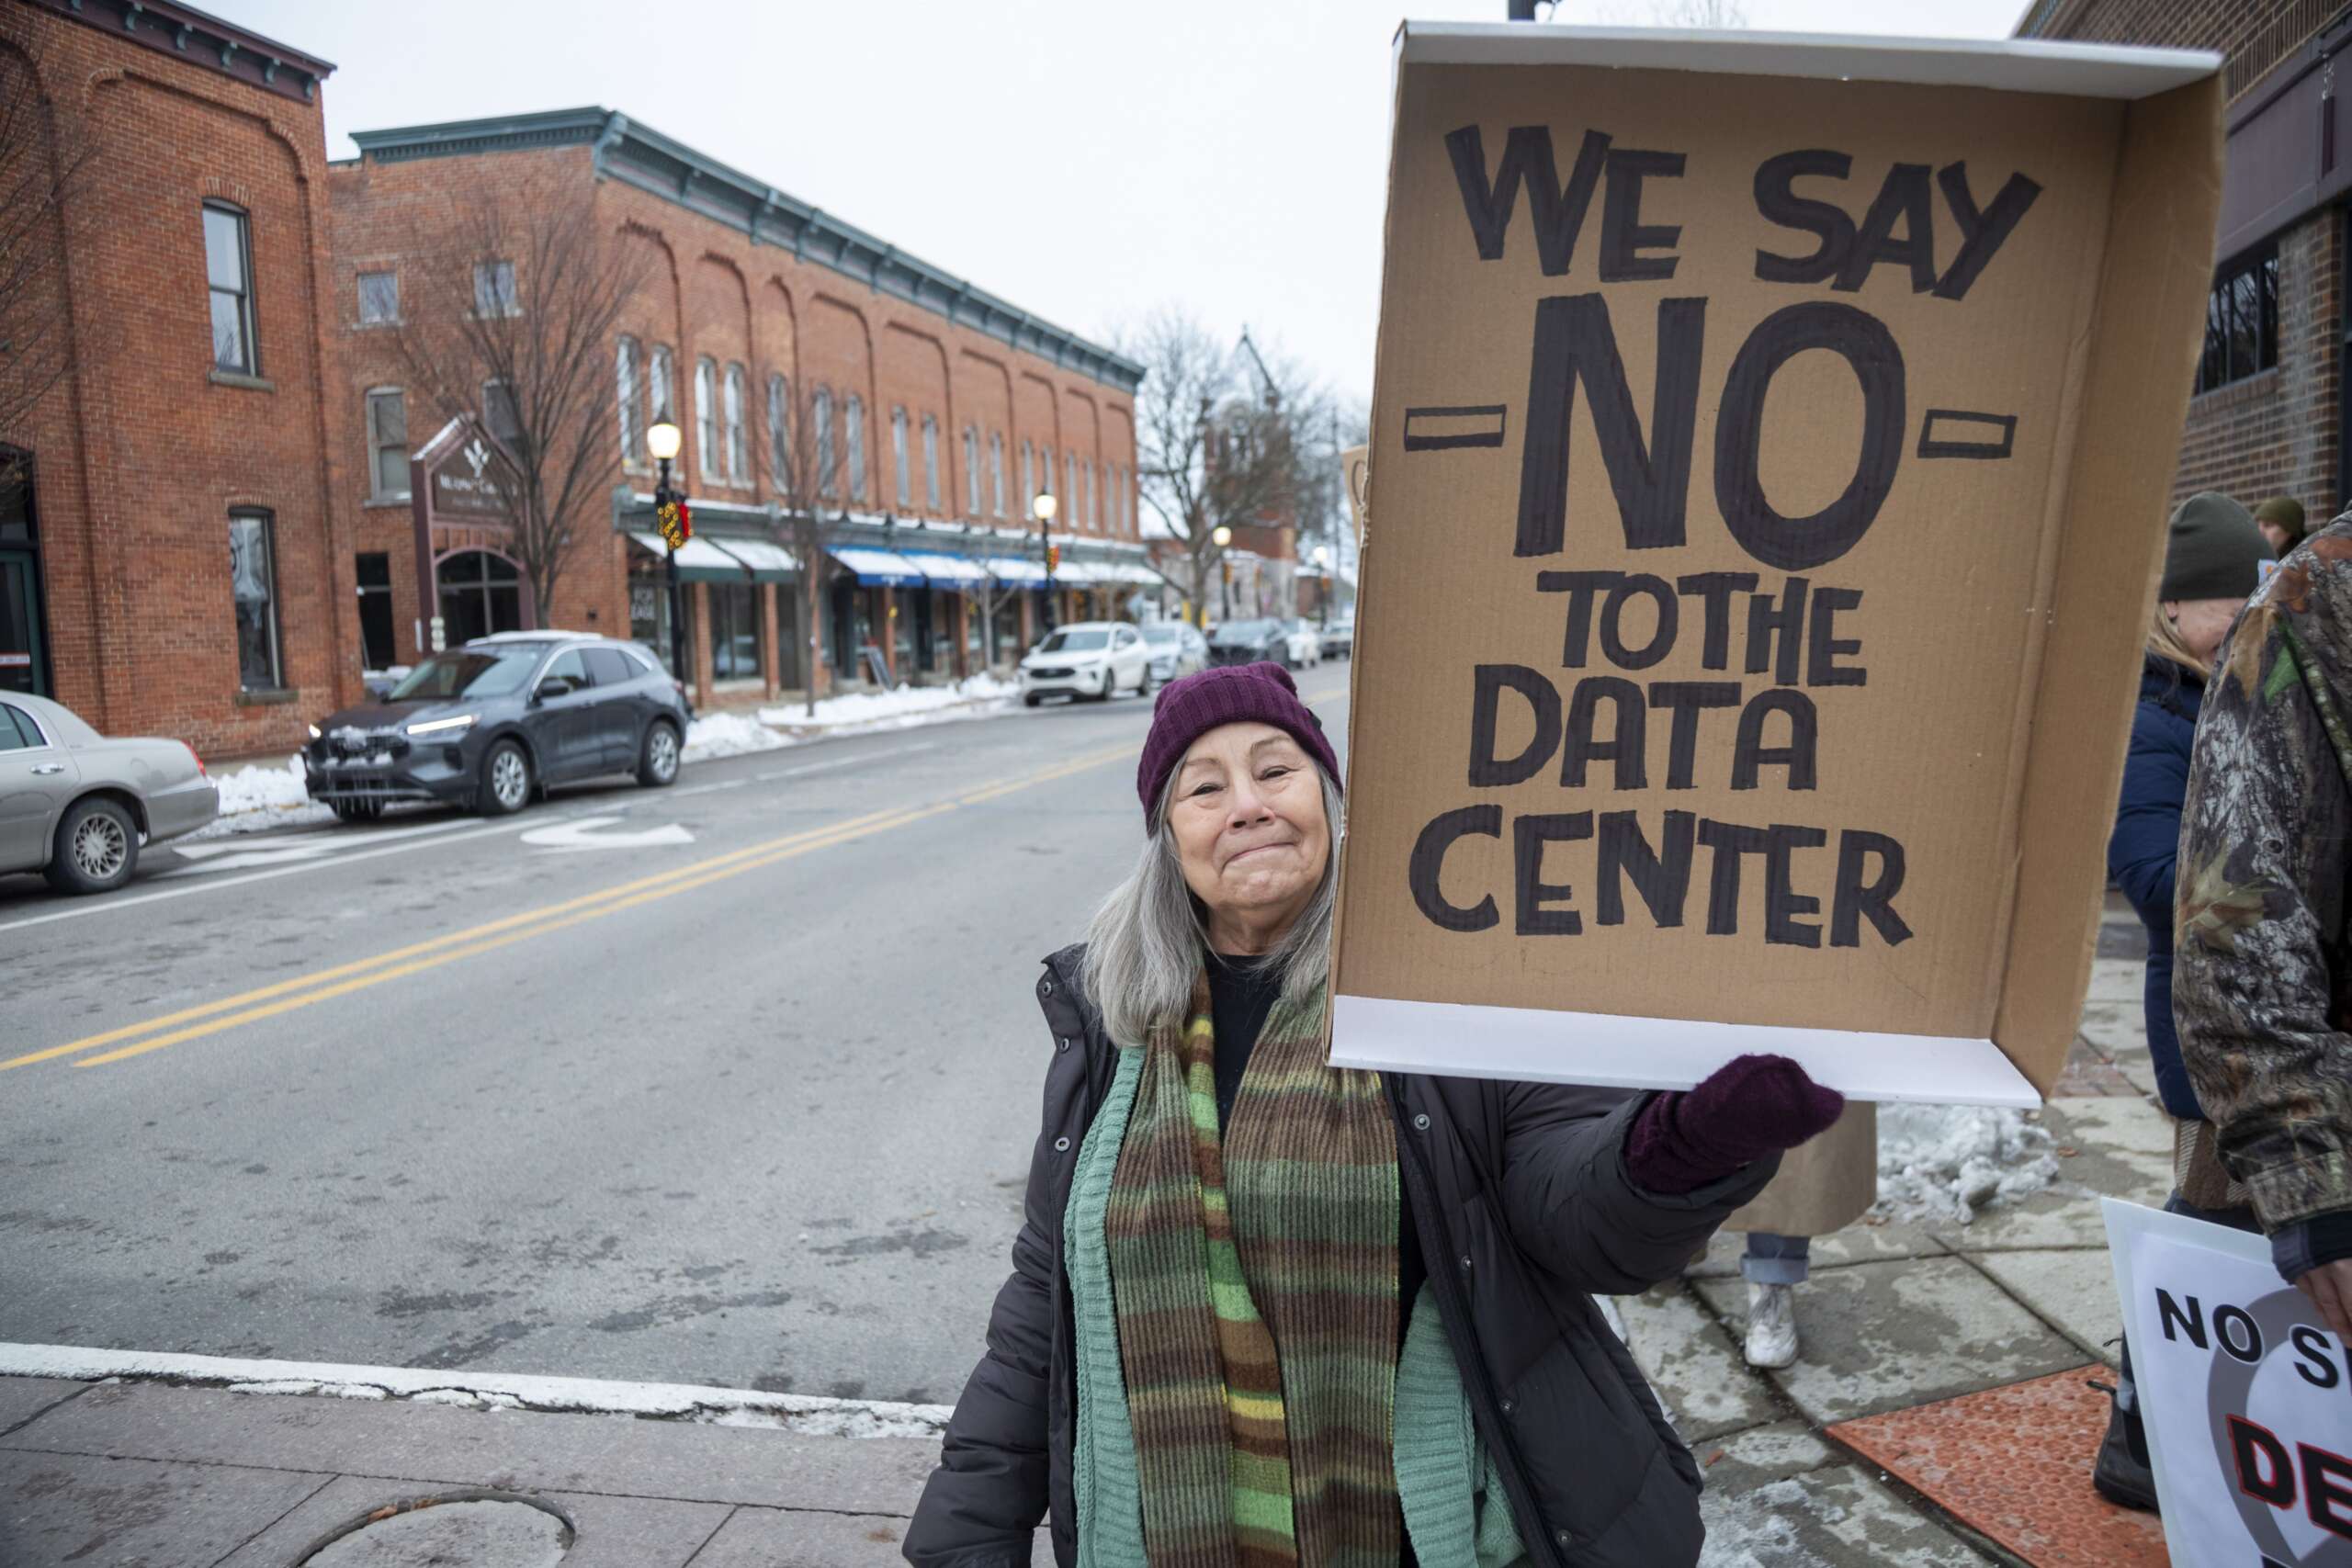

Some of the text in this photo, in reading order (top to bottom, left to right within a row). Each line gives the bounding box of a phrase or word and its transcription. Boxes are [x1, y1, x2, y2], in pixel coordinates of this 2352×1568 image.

[1444, 124, 2043, 301] WE SAY
[1512, 292, 1905, 571] NO
[1537, 570, 1866, 687] TO THE
[1468, 664, 1818, 791] DATA
[1408, 804, 1914, 948] CENTER
[2156, 1287, 2263, 1364] NO
